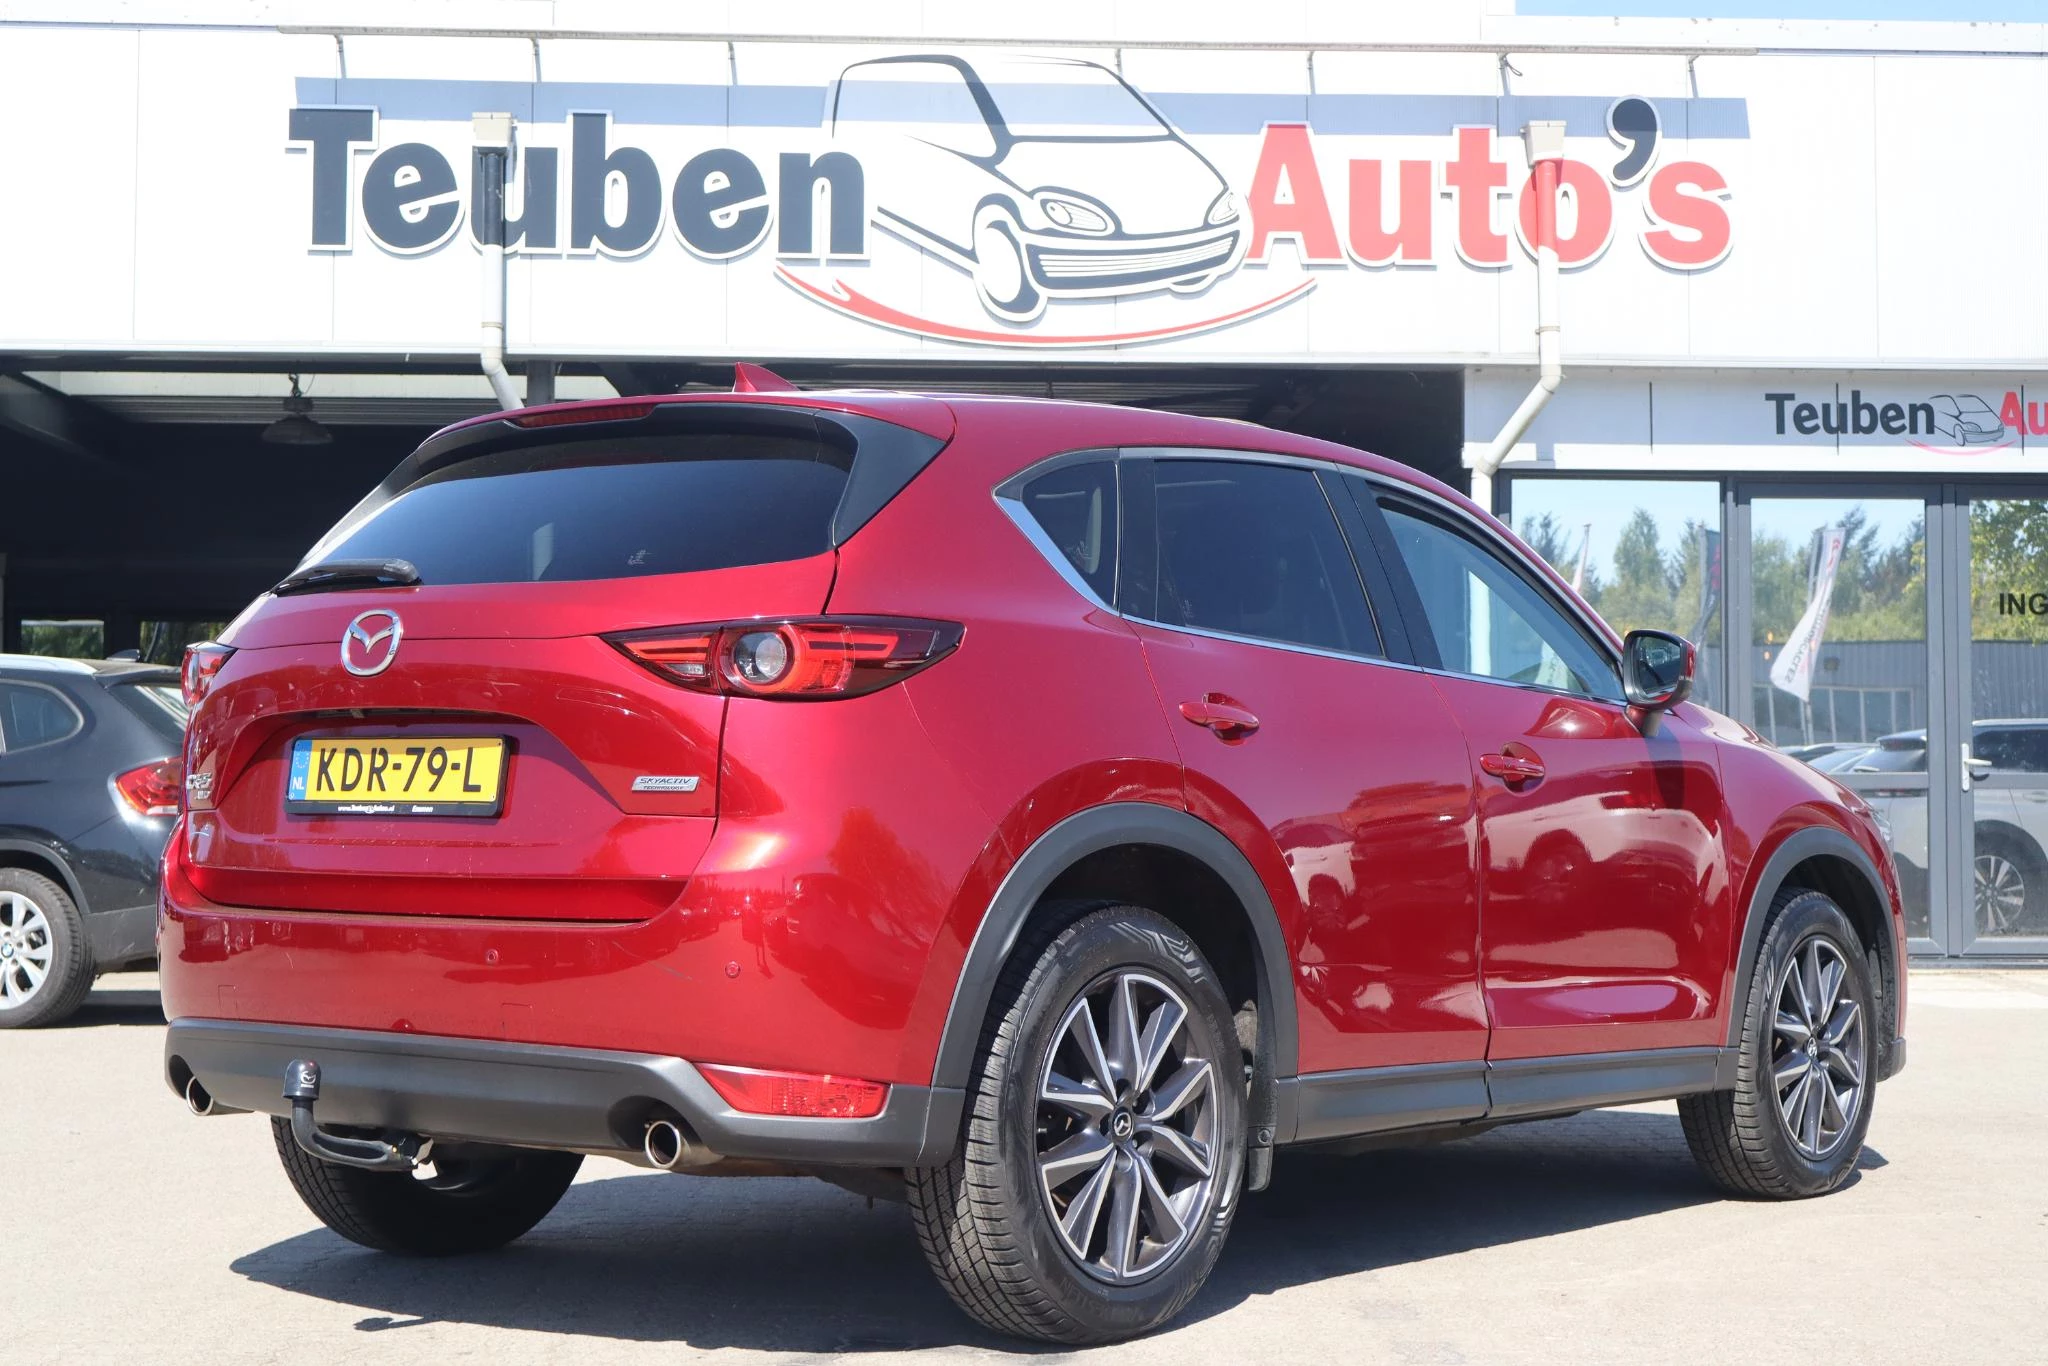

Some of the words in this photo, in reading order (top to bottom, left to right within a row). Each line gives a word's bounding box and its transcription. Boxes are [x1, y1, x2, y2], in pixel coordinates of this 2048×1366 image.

[287, 106, 867, 257] Teuben
[1246, 97, 1733, 266] Auto's
[1765, 390, 1935, 435] Teuben
[2000, 593, 2048, 615] ING
[292, 776, 305, 790] NL
[316, 747, 481, 792] KDR-79-L
